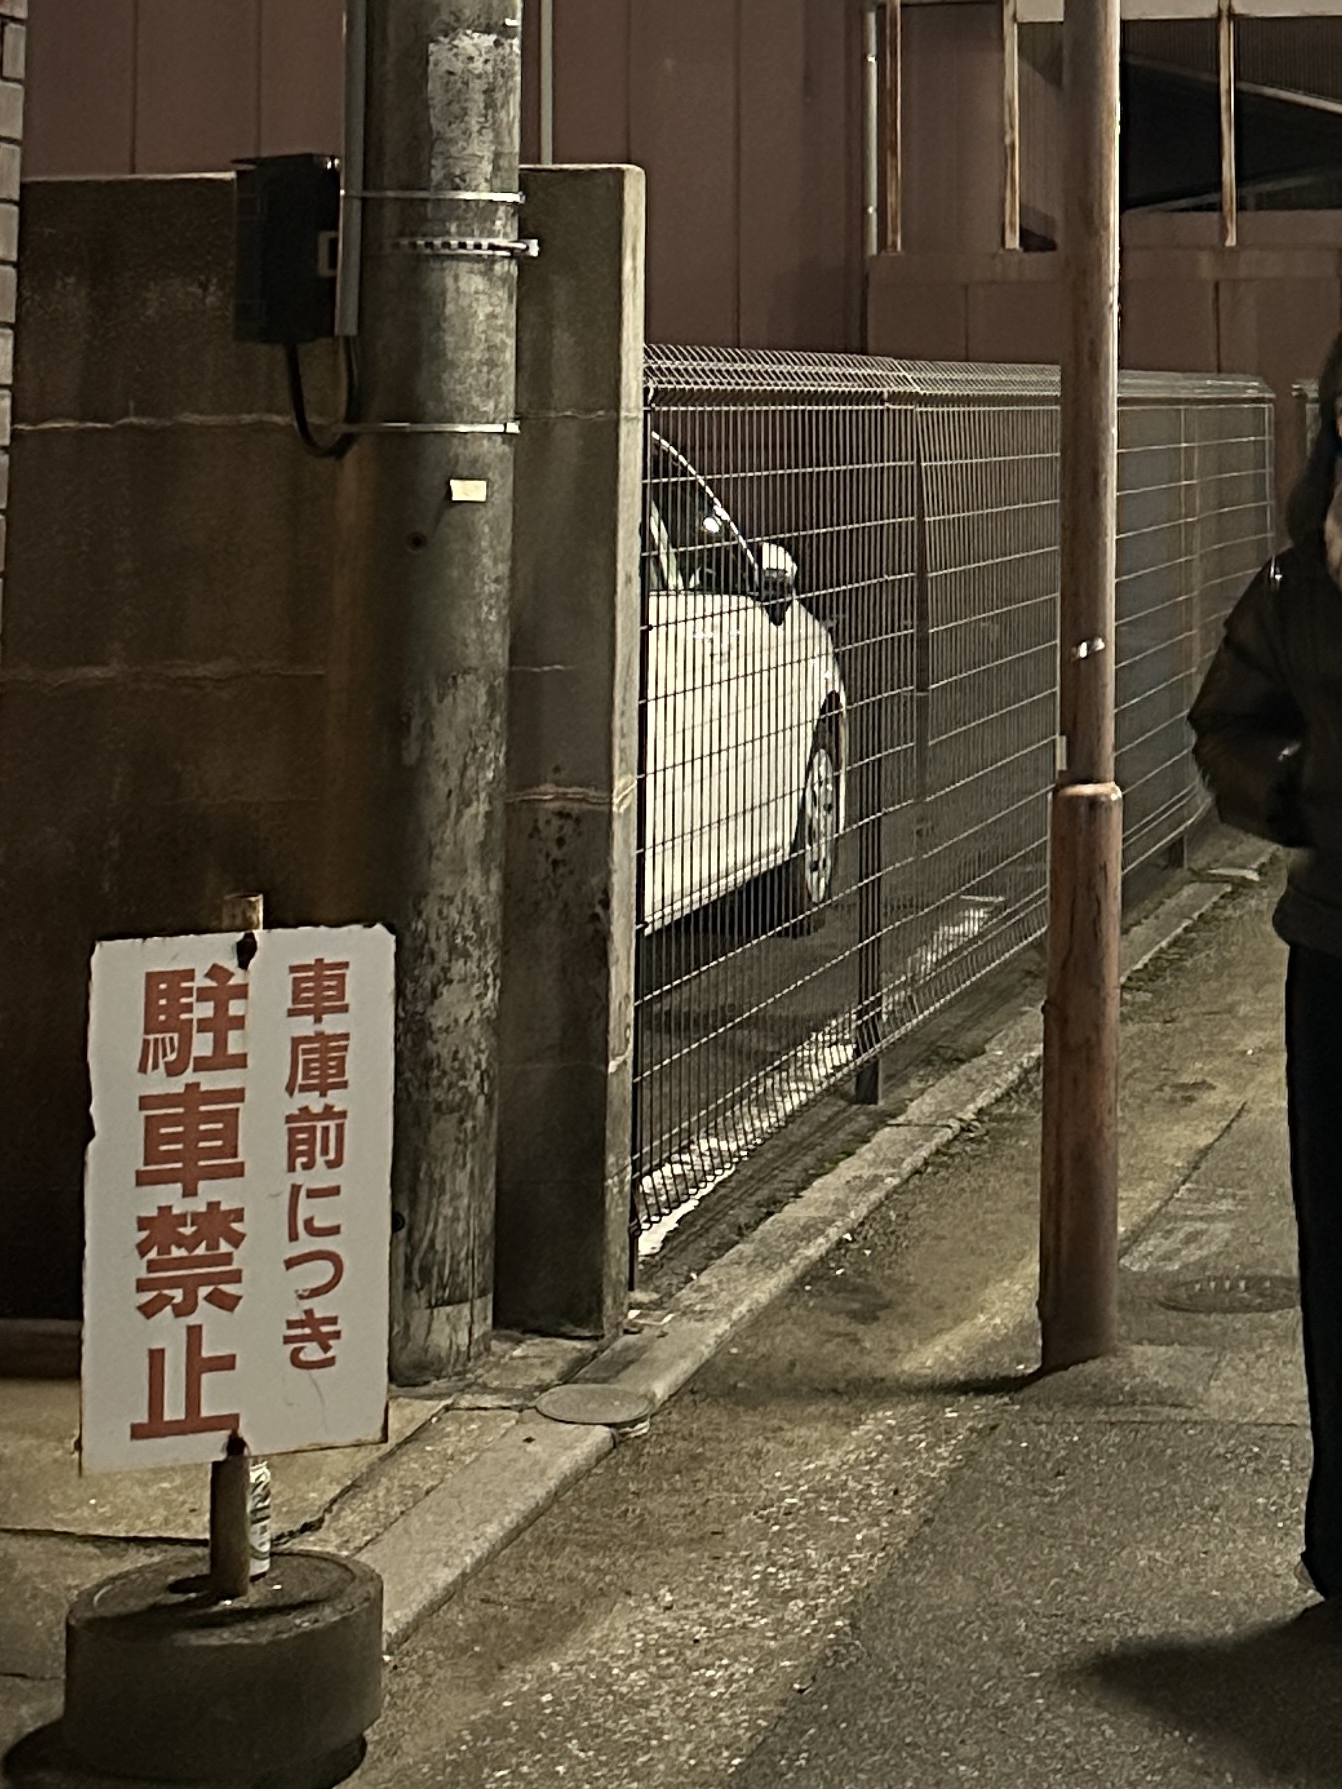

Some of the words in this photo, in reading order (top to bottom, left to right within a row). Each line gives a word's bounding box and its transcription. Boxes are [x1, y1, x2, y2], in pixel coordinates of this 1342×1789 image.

[130, 963, 249, 1442] 駐車禁止
[283, 957, 351, 1371] 車庫前につき
